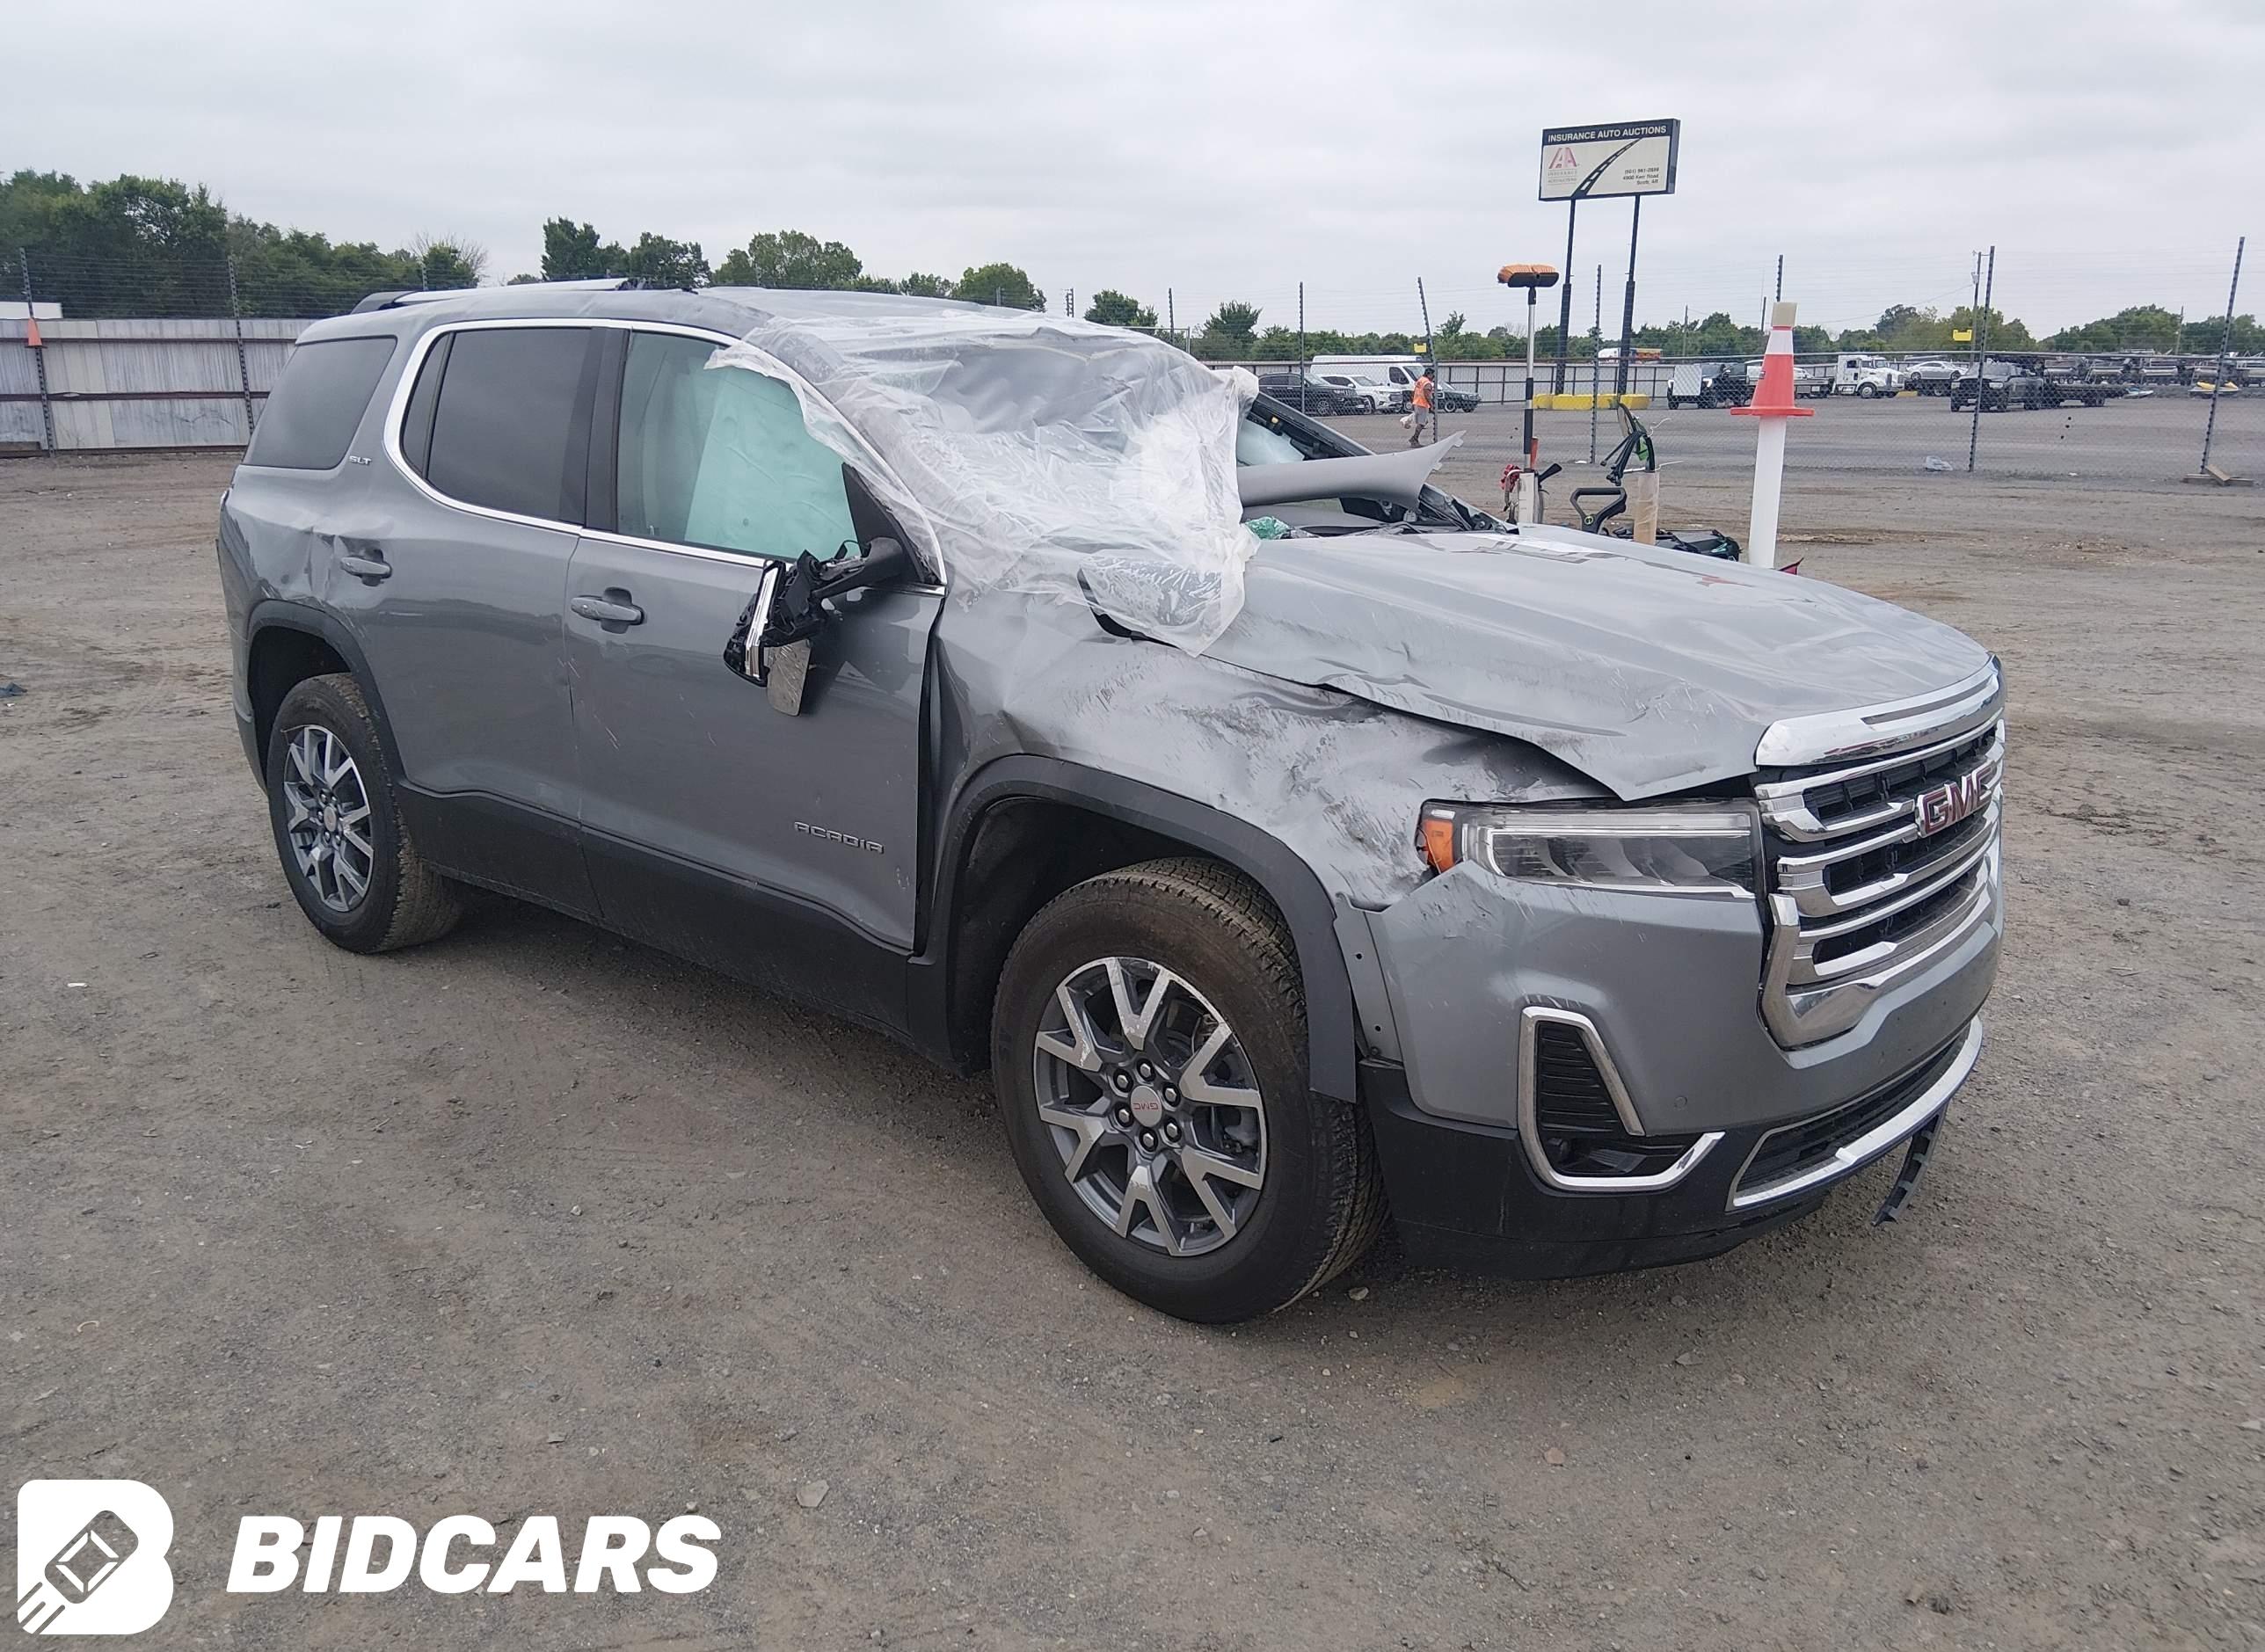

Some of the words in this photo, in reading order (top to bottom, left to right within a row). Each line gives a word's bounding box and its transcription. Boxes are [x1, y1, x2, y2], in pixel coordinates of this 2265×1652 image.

[1548, 131, 1596, 143] INSURANCE
[1597, 129, 1621, 139] AUTO
[1622, 125, 1667, 136] AUCTIONS
[349, 455, 372, 465] SLT
[1917, 760, 1998, 839] GMC
[794, 821, 884, 855] ACADIA
